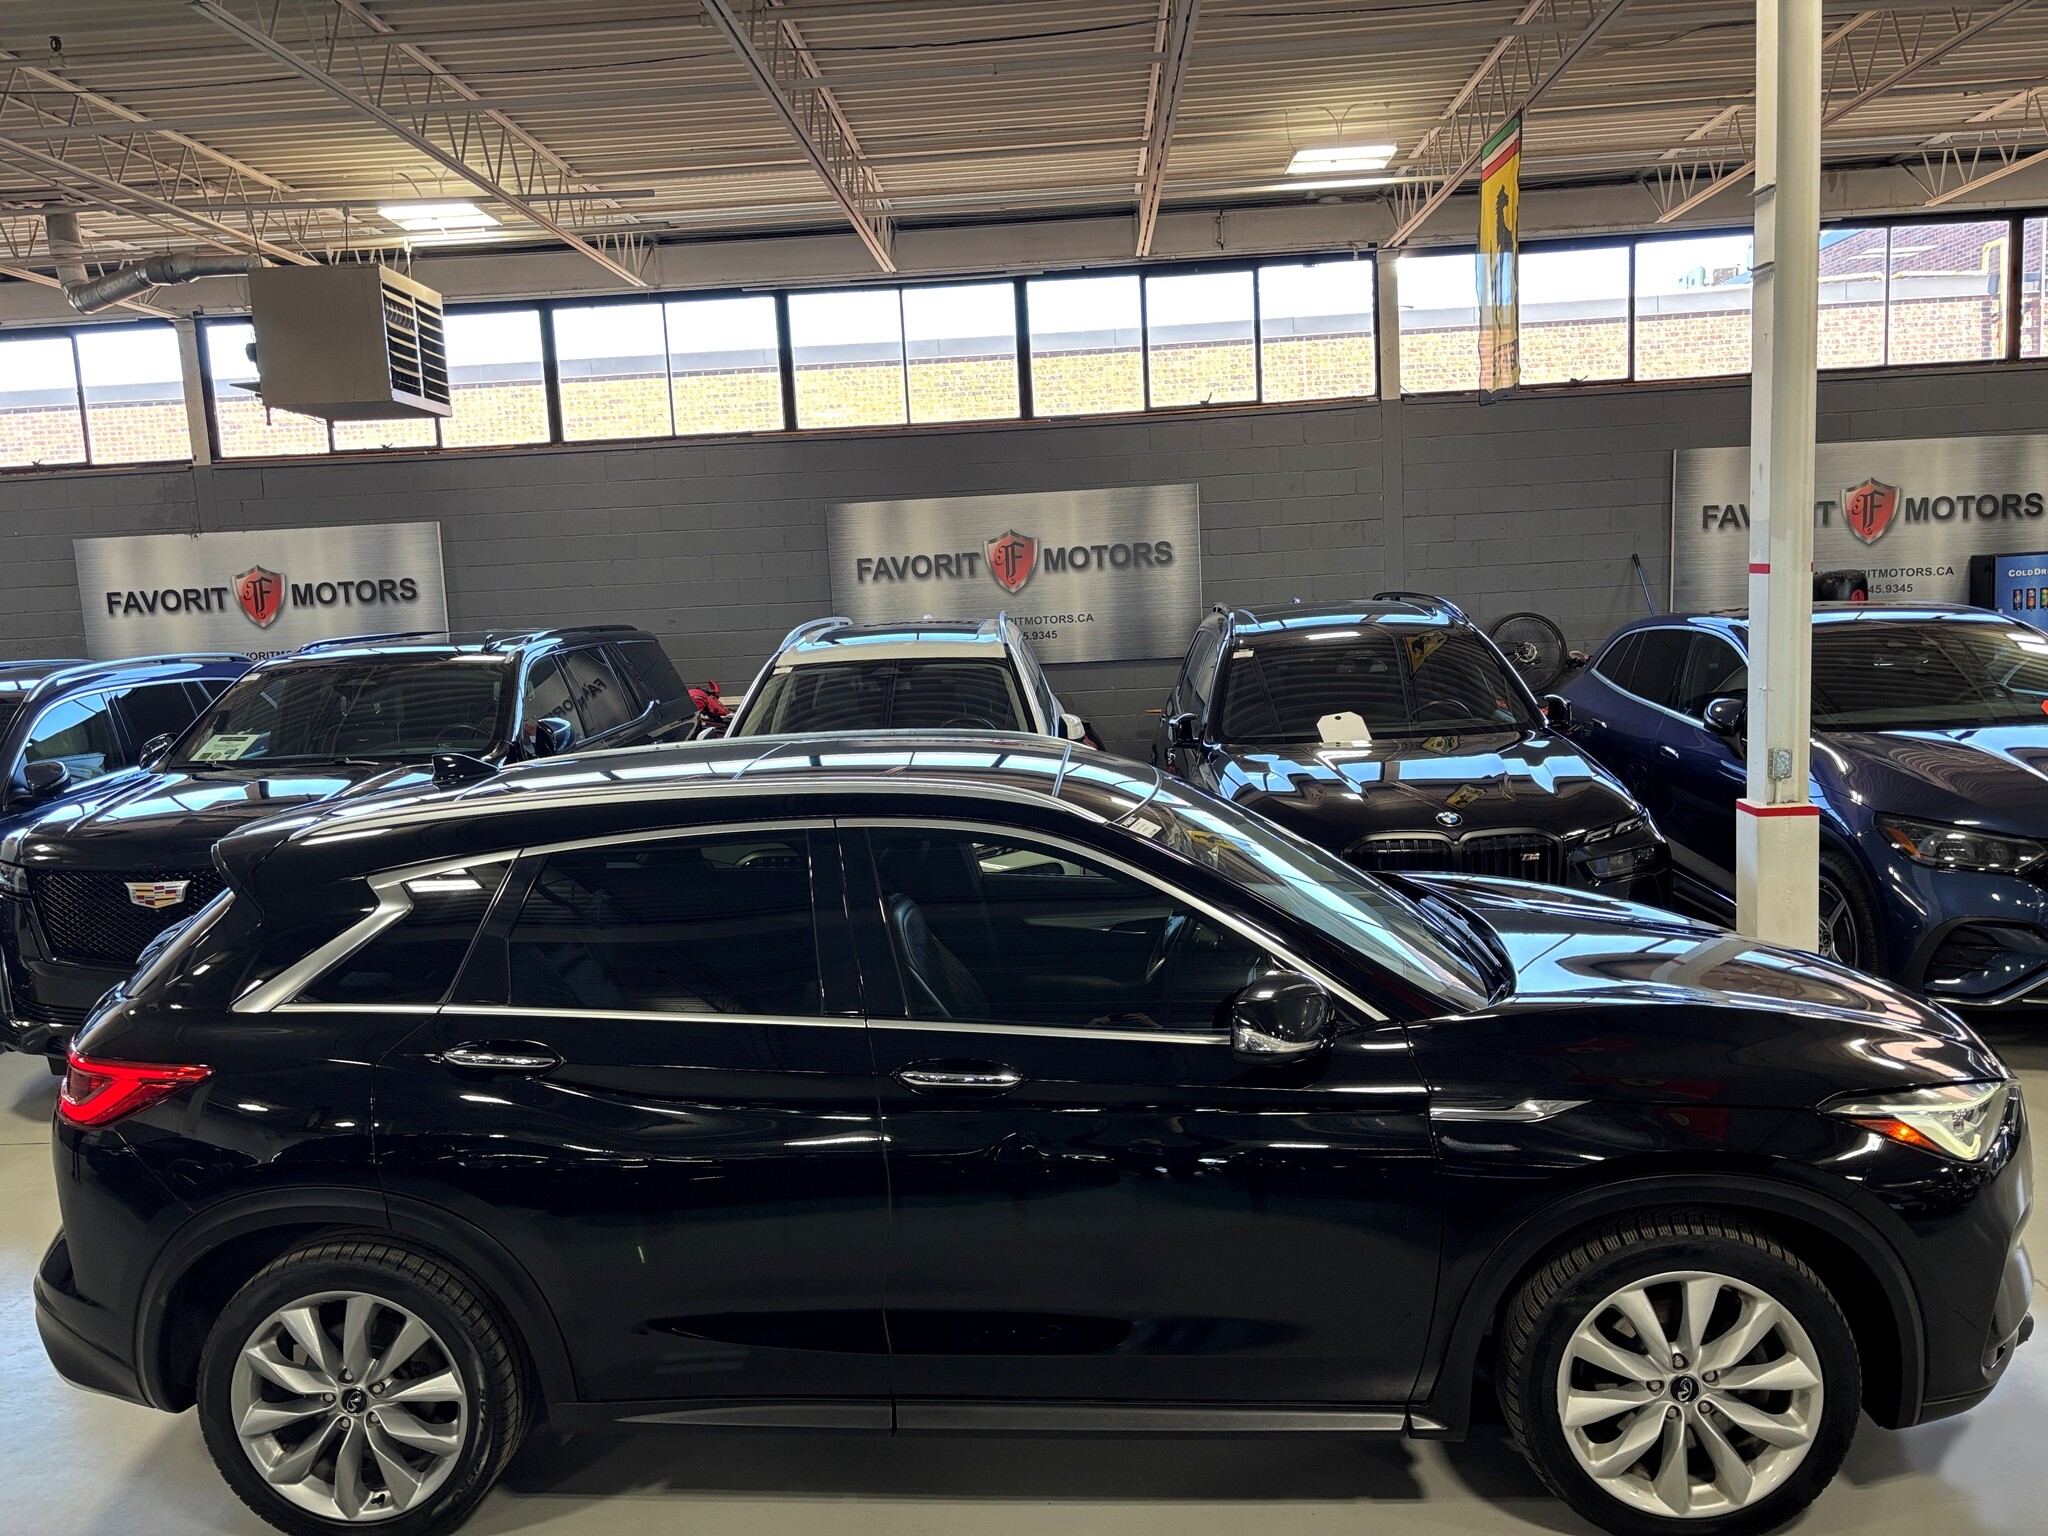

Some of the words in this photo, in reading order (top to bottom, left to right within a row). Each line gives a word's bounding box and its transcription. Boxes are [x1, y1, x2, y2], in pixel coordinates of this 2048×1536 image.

[1905, 492, 2044, 521] MOTORS
[857, 552, 980, 581] FAVORIT
[1044, 541, 1173, 571] MOTORS
[2034, 568, 2048, 576] DR
[106, 586, 227, 615] FAVORIT
[291, 577, 418, 606] MOTORS
[1868, 584, 1914, 594] 45.9345
[1023, 630, 1058, 641] 5.9345
